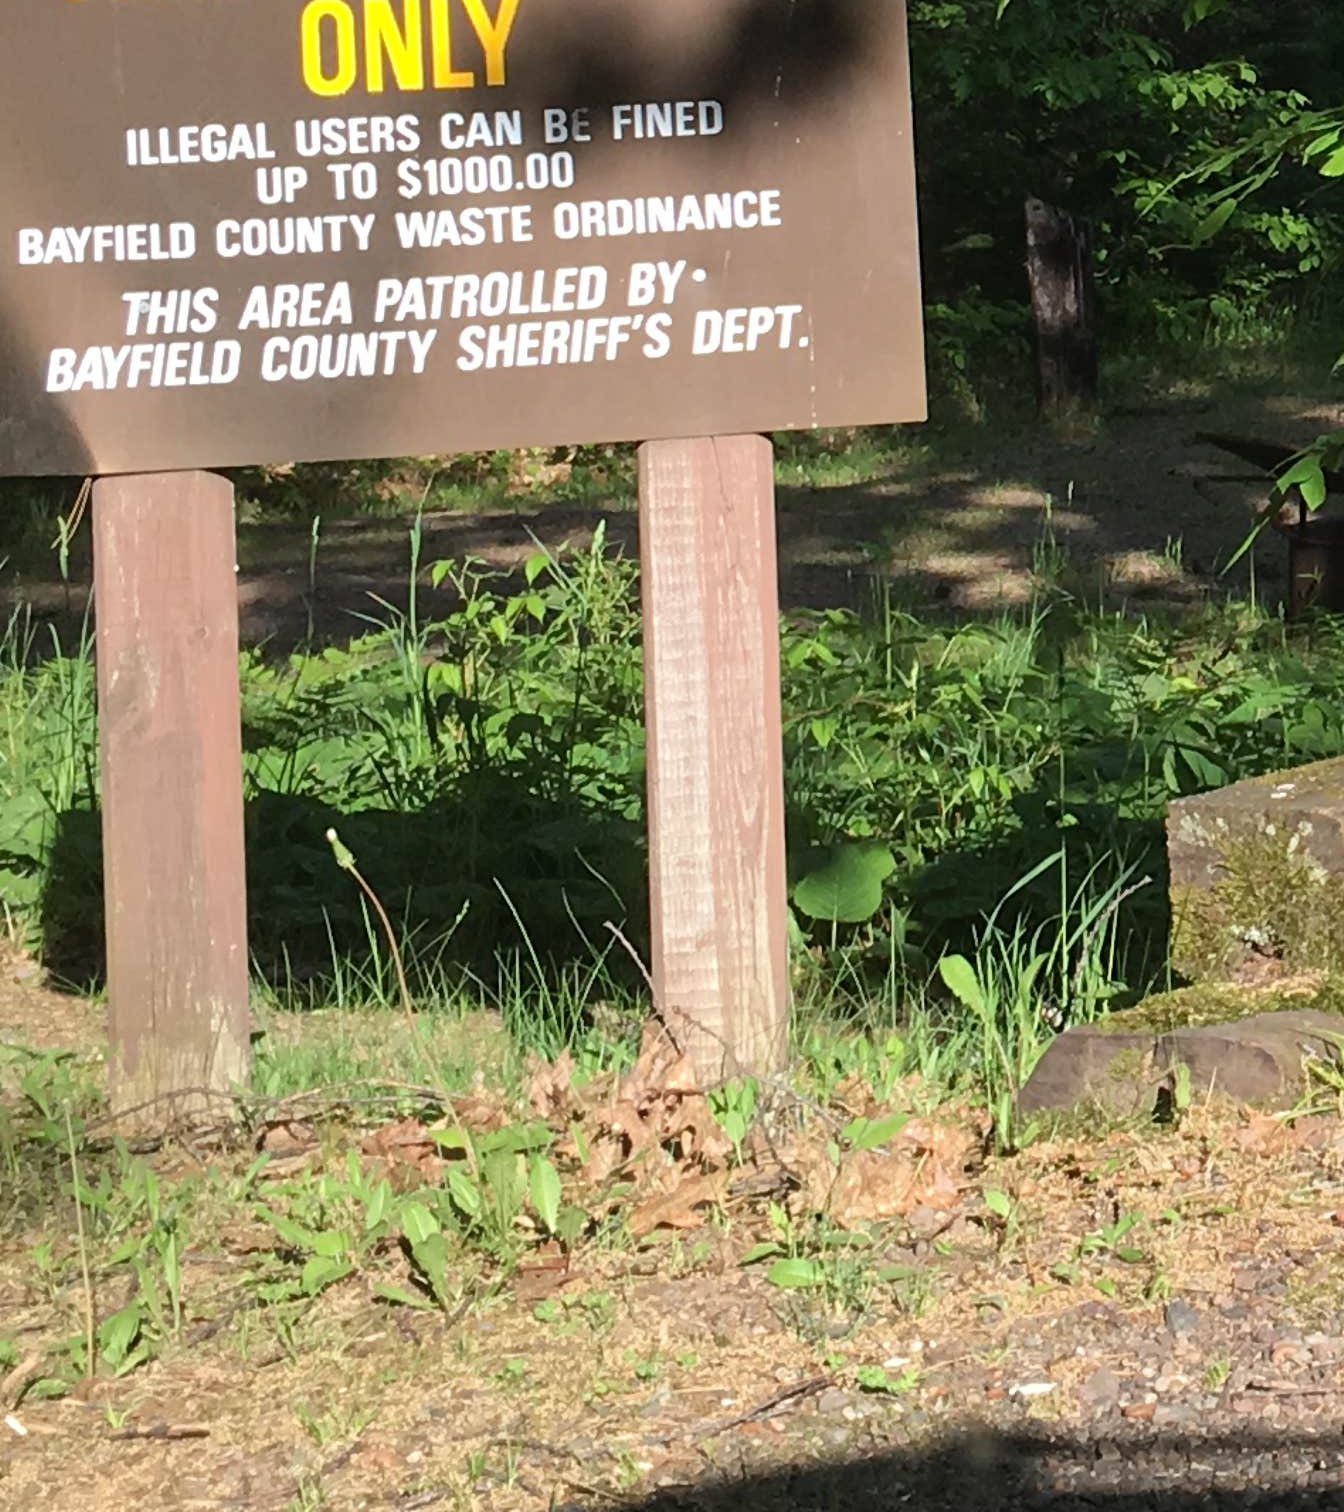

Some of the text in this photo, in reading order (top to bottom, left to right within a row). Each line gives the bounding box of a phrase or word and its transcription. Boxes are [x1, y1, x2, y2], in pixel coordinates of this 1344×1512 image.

[126, 100, 724, 166] ILLEGAL USERS CAN BE FINED
[256, 151, 575, 204] UP TO $1000.00
[18, 190, 782, 267] BAYFIELD COUNTY WASTE ORDINANCE
[121, 287, 220, 336] THIS
[238, 281, 353, 330] AREA
[375, 264, 608, 322] PATROLLED
[46, 304, 809, 393] BAYFIELD COUNTY SHERIFF'S DEPT.
